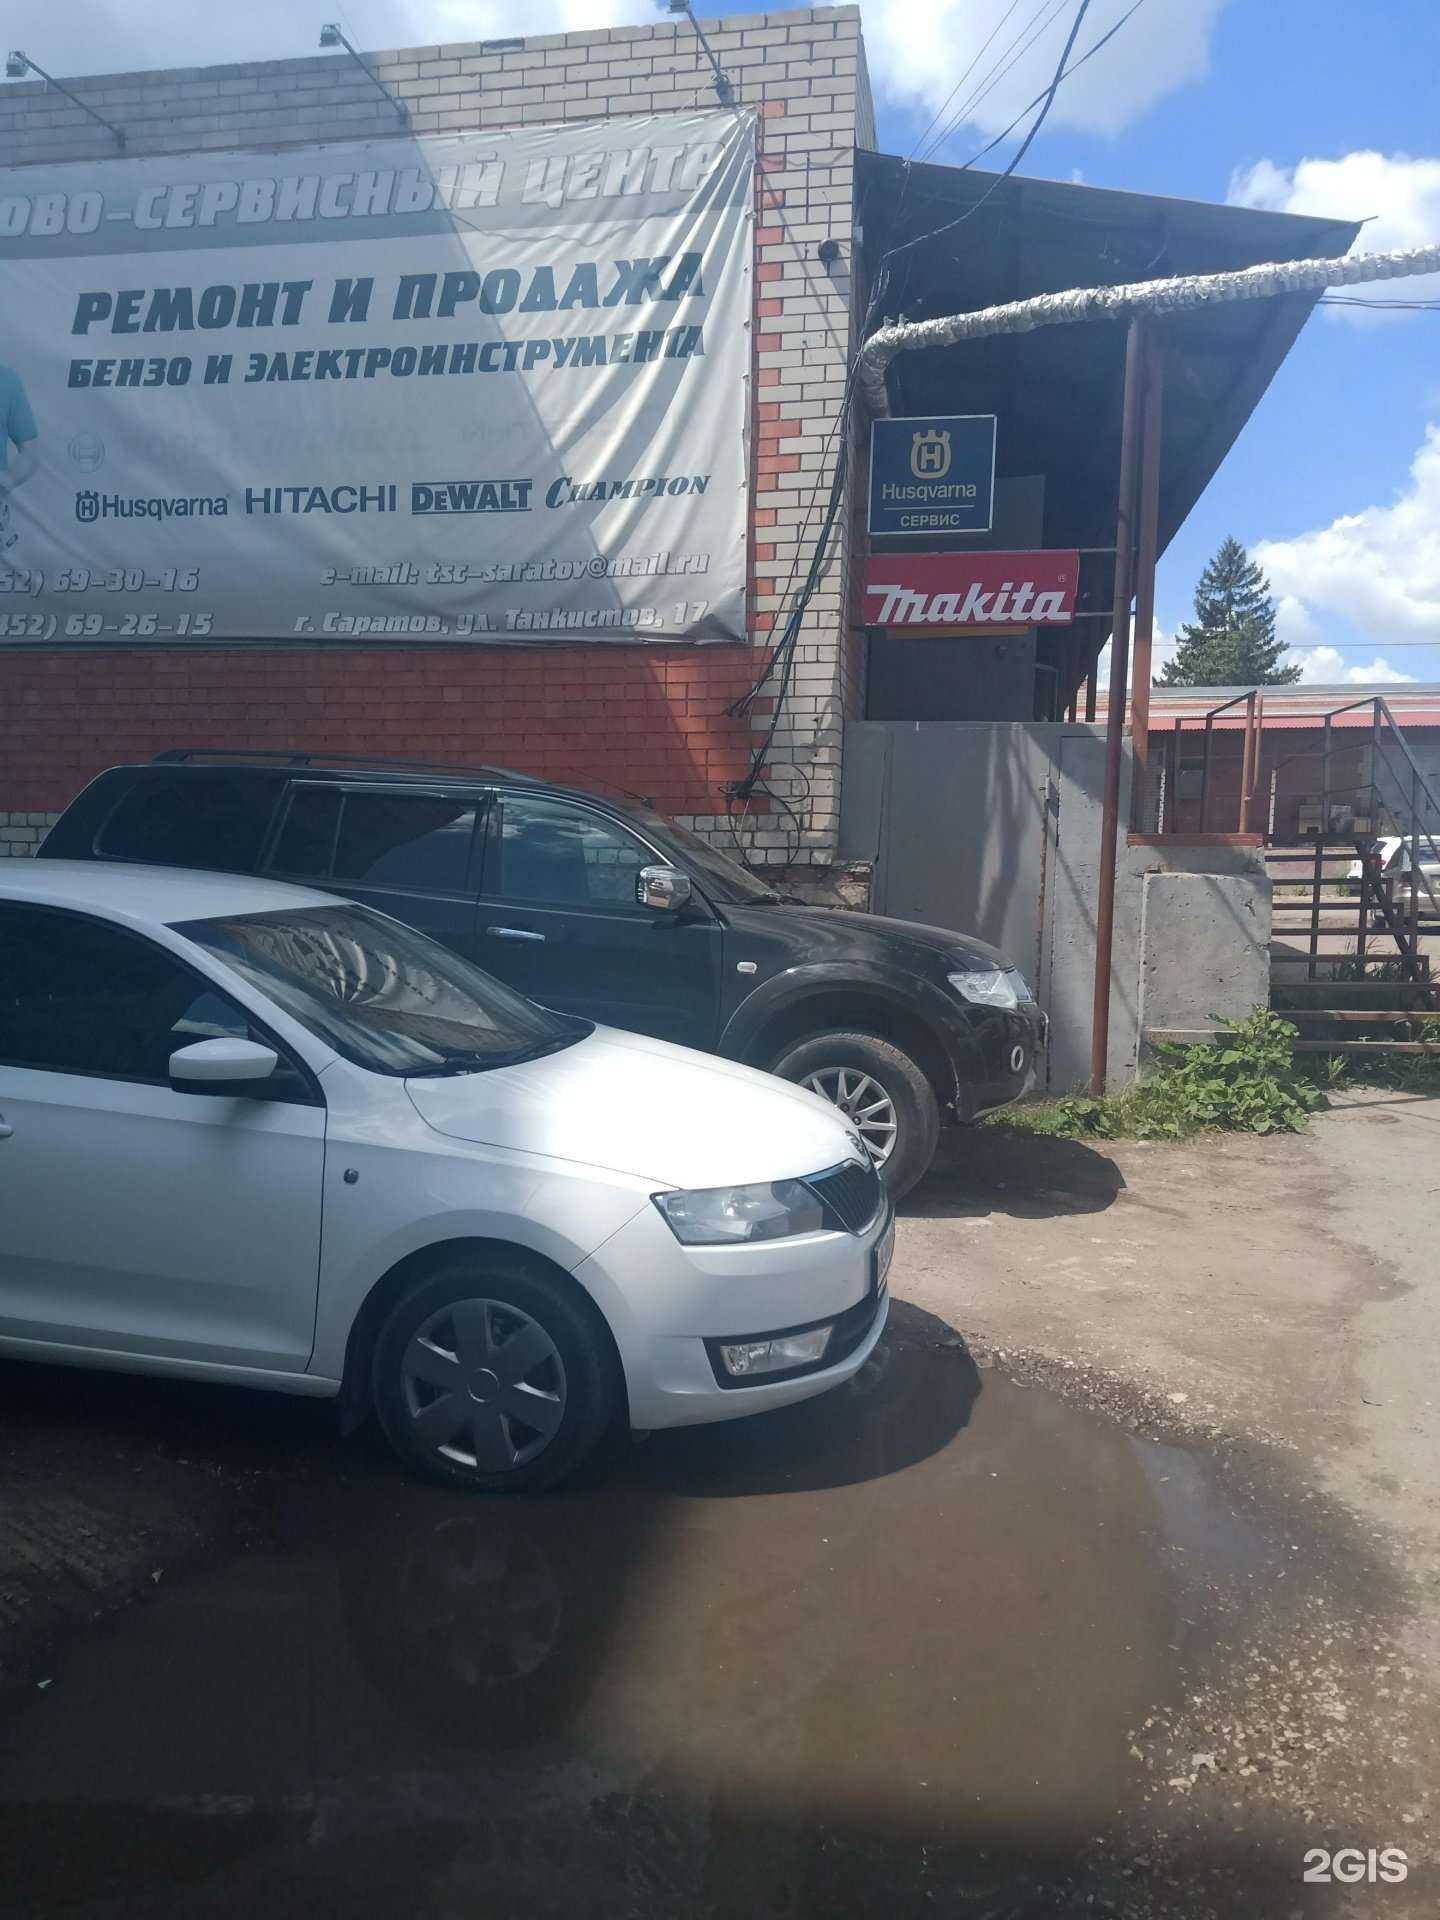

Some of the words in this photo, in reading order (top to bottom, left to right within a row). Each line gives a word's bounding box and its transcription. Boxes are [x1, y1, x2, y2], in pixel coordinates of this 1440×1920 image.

[521, 142, 725, 209] ЦЕНТР
[72, 280, 314, 335] РЕМОНТ
[328, 277, 374, 323] И
[392, 252, 706, 321] ПРОДАЖА
[68, 355, 192, 389] БЕНЗО
[204, 354, 233, 385] И
[244, 325, 706, 384] ЭЛЕКТРОИНСТРУМЕНТА
[103, 494, 228, 521] Husqvarna
[246, 485, 396, 514] HITACHI
[545, 475, 713, 510] CHAMPION
[882, 484, 977, 501] Husqvarna
[900, 513, 960, 528] СЕРВИС
[53, 567, 200, 593] 69-30-16
[320, 562, 419, 586] e-mail:
[426, 552, 711, 585] tsc-saratov@mail.ru
[65, 612, 214, 637] 69-26-15
[322, 611, 449, 635] Саратов,
[455, 613, 497, 635] ул.
[505, 606, 664, 633] Танкистов,
[673, 600, 710, 624] 17
